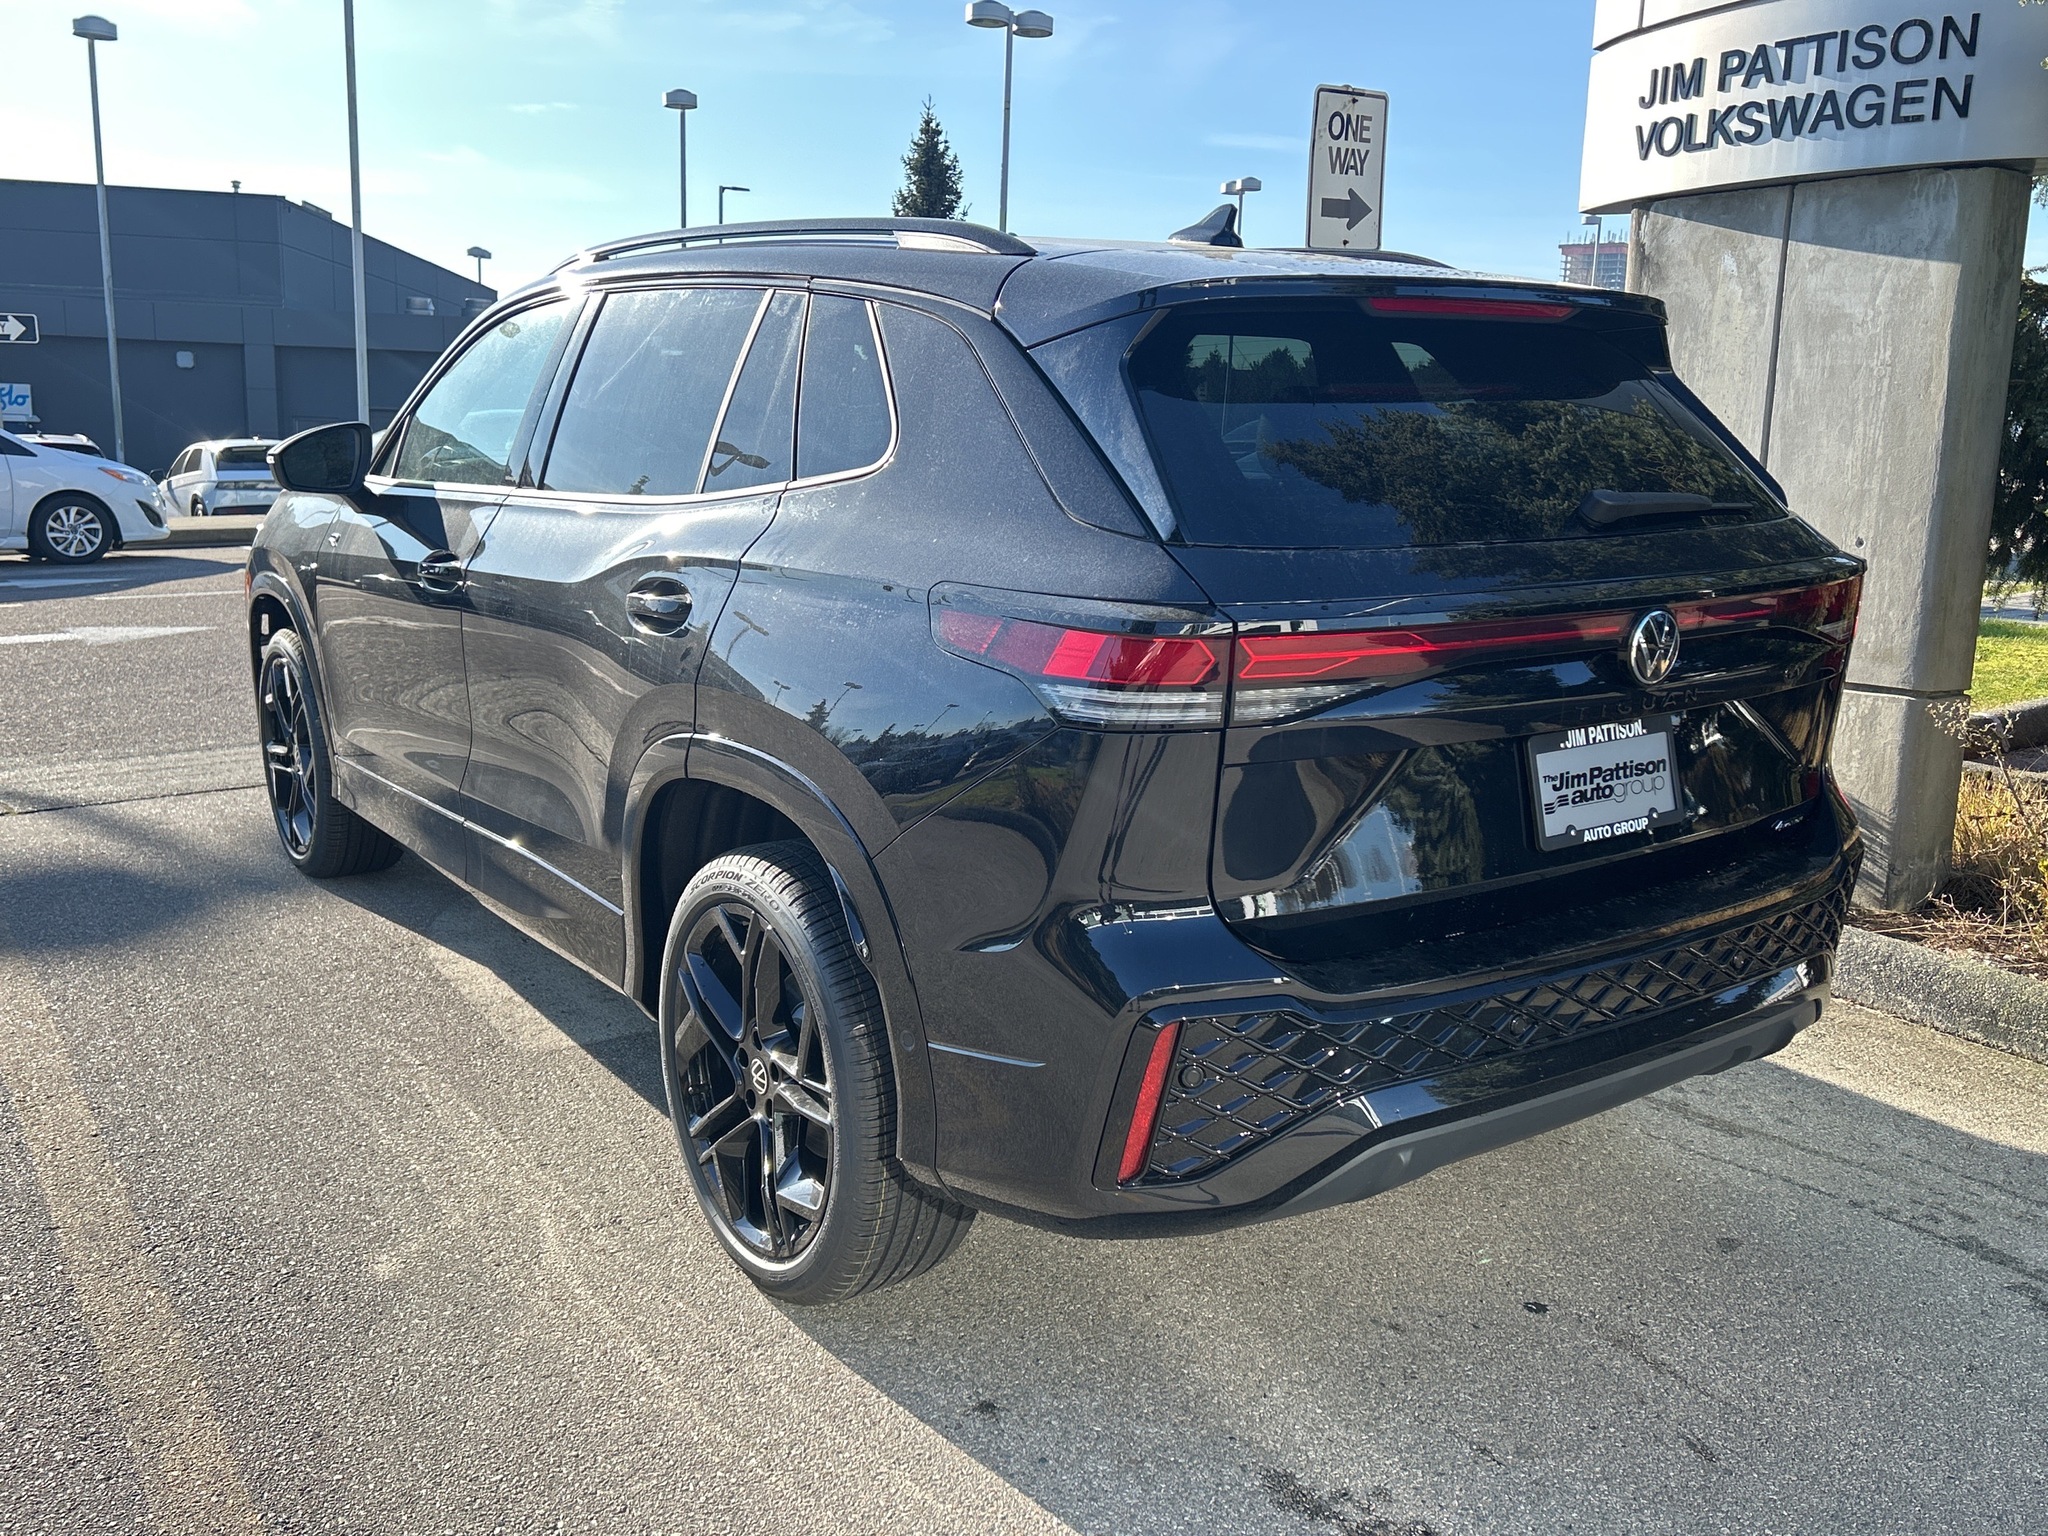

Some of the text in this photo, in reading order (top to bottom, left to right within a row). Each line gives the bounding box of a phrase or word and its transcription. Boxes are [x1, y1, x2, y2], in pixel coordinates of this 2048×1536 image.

[1638, 12, 1981, 109] JIM PATTISON
[1328, 111, 1373, 144] ONE
[1635, 74, 1975, 161] VOLKSWAGEN
[1328, 146, 1370, 176] WAY
[1575, 688, 1699, 719] TIGUAN
[1566, 719, 1643, 748] JIM PATTISON
[1543, 774, 1559, 784] The
[1583, 817, 1649, 842] AUTO GROUP
[689, 870, 744, 896] SCORPION
[745, 878, 781, 912] ZERO
